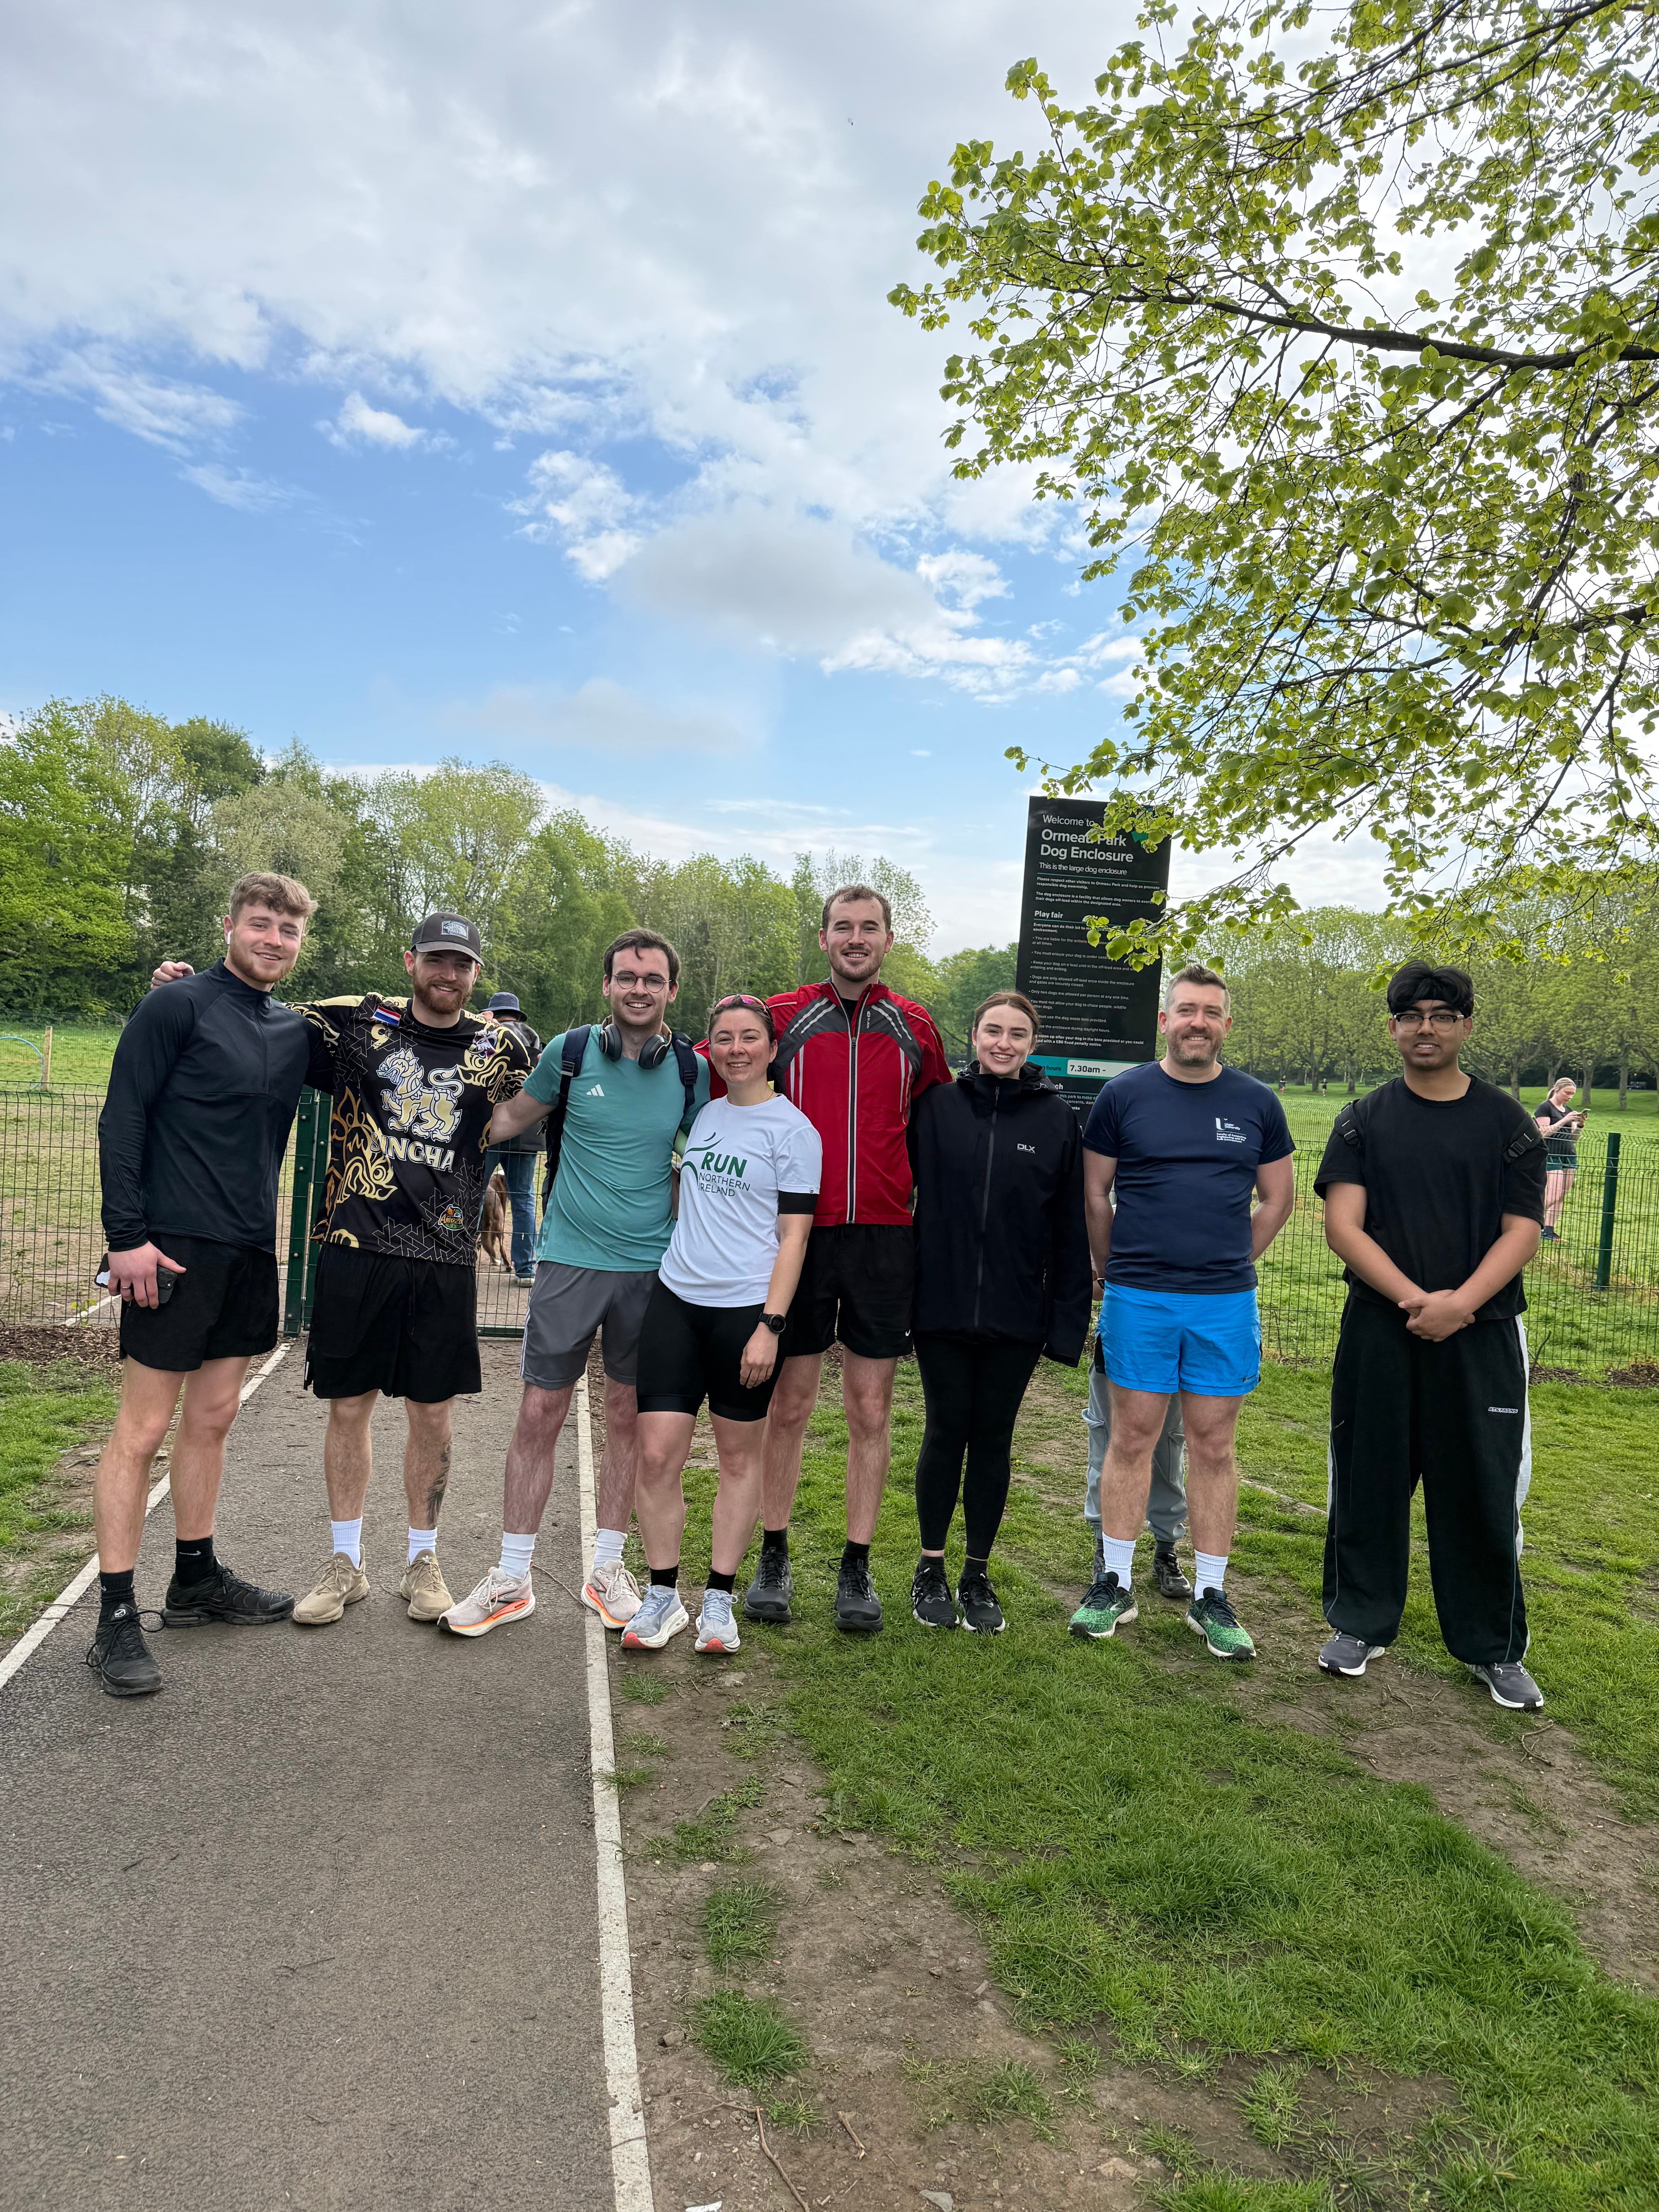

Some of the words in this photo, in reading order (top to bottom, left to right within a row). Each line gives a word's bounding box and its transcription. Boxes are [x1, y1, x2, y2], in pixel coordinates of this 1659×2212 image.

[1043, 814, 1084, 826] Welcome
[1086, 818, 1094, 827] to
[1042, 829, 1094, 843] Ormeau
[1097, 832, 1127, 846] Park
[1041, 844, 1067, 860] Dog
[1071, 846, 1133, 862] Enclosure
[1069, 864, 1084, 872] large
[1085, 866, 1097, 874] dog
[1070, 1065, 1100, 1073] 7.30am
[371, 1132, 455, 1173] SINGHA
[1017, 1143, 1035, 1152] DLX
[701, 1152, 747, 1178] RUN
[699, 1172, 750, 1191] NORTHERN
[698, 1183, 735, 1197] IRELAND
